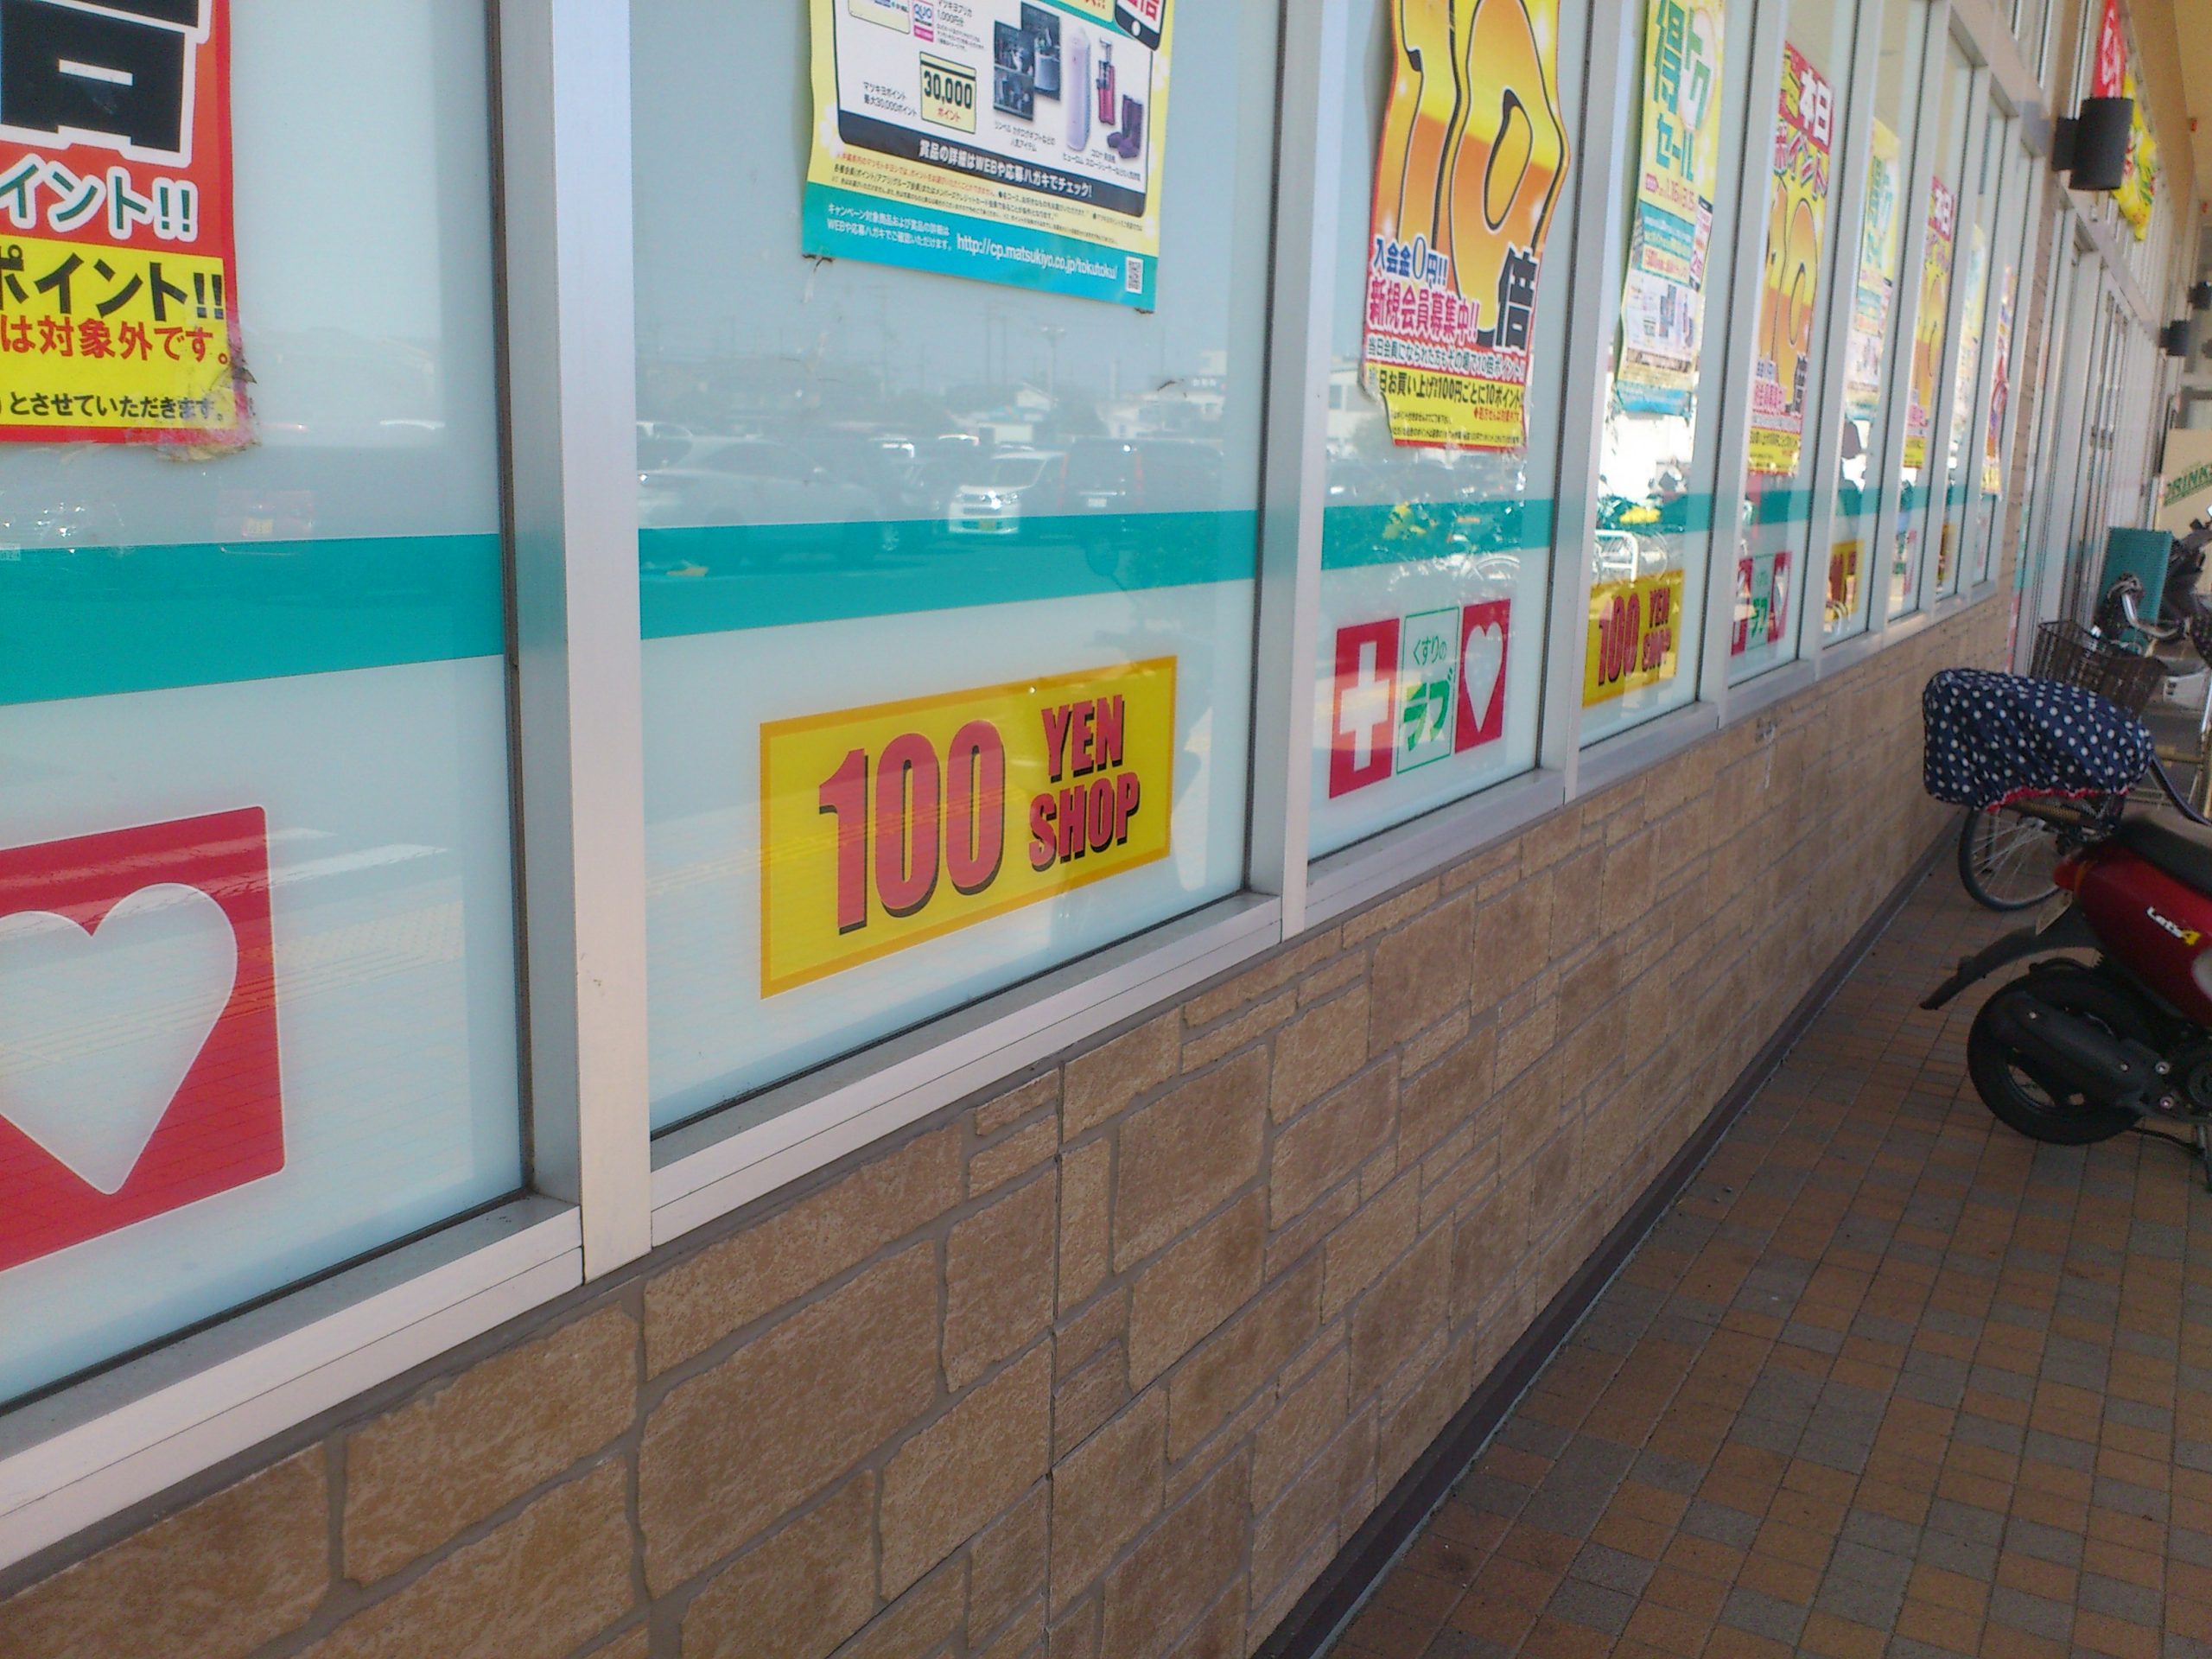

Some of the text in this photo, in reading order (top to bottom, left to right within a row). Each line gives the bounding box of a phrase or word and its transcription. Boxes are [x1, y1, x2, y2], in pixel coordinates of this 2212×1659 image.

[924, 70, 973, 110] 30,000
[0, 315, 230, 365] は対象外です。
[0, 391, 224, 423] とさせていただきます。
[1413, 634, 1447, 666] くすりの
[1598, 591, 1640, 687] 100
[1041, 694, 1125, 784] YEN
[1402, 666, 1454, 752] ラブ
[818, 719, 1006, 936] 100
[1028, 772, 1141, 873] SHOP
